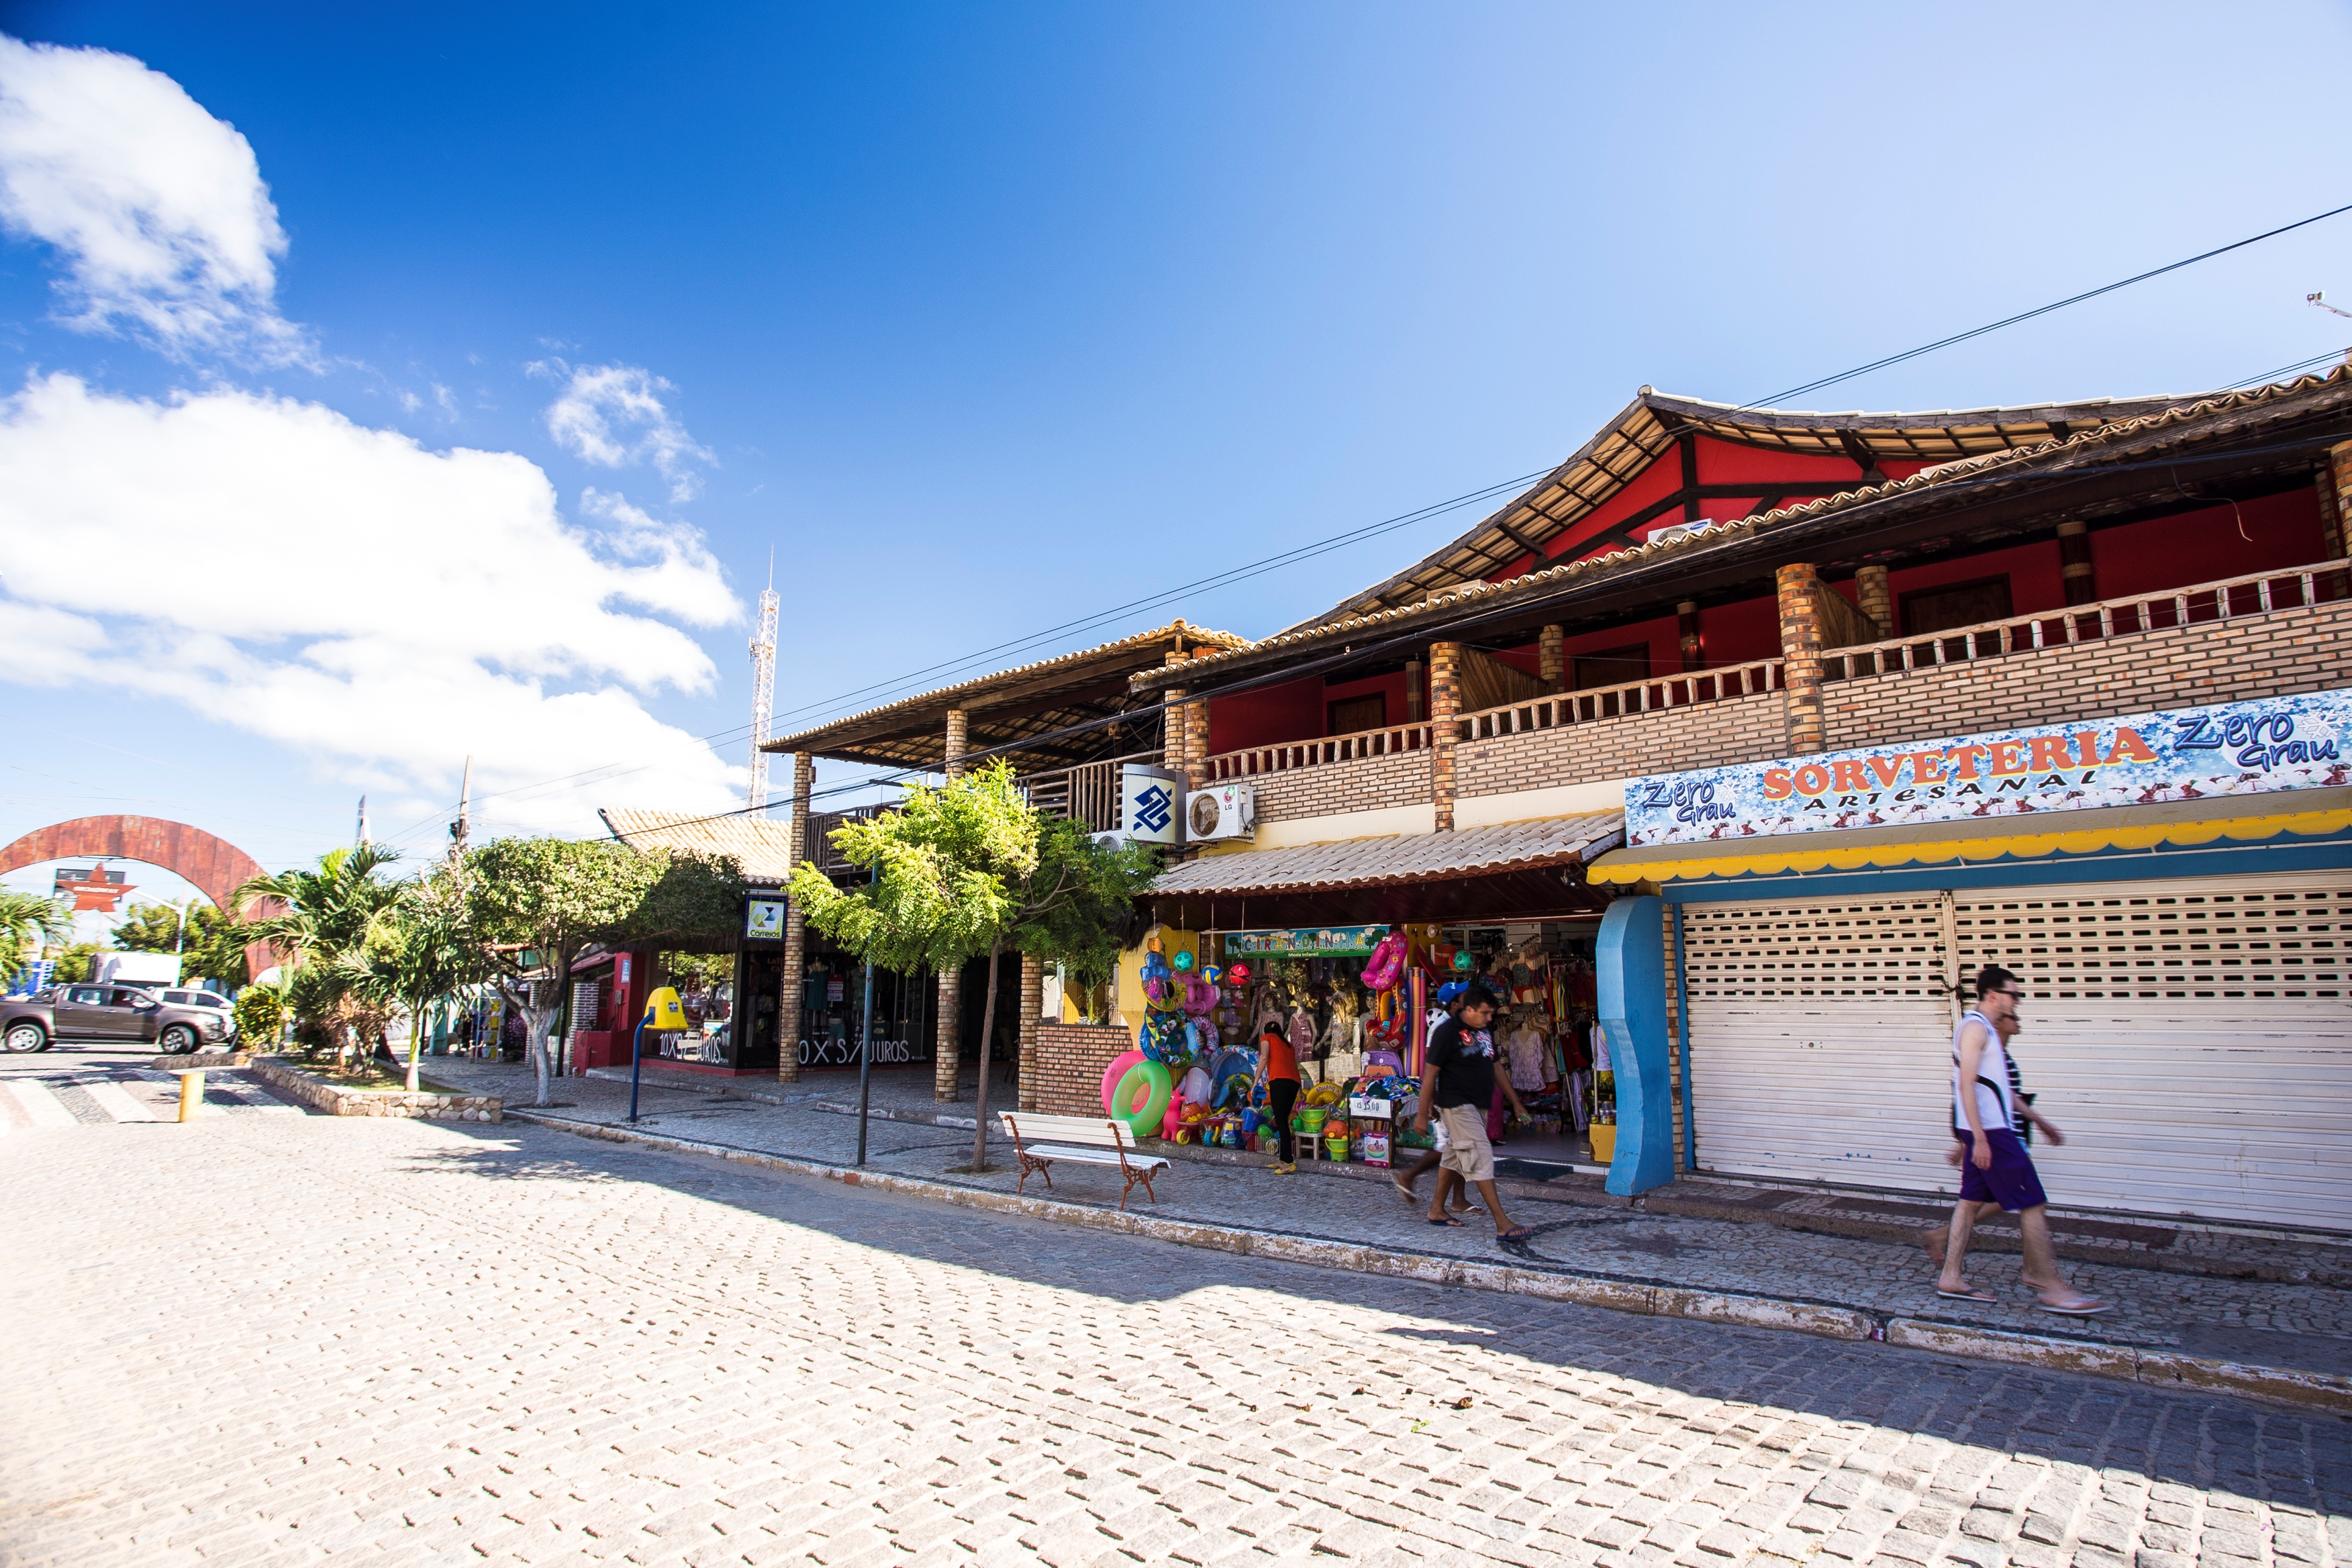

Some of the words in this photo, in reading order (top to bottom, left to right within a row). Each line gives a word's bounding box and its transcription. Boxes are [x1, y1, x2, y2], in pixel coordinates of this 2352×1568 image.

[2173, 712, 2296, 751] Zero
[1763, 727, 2159, 801] SORVETERIA
[2237, 740, 2339, 772] Grau
[1643, 780, 1714, 807] Zero
[1676, 802, 1736, 826] Grau
[750, 930, 780, 938] Correios
[1244, 932, 1365, 952] CIRANDINHA
[869, 1040, 910, 1063] JUROS
